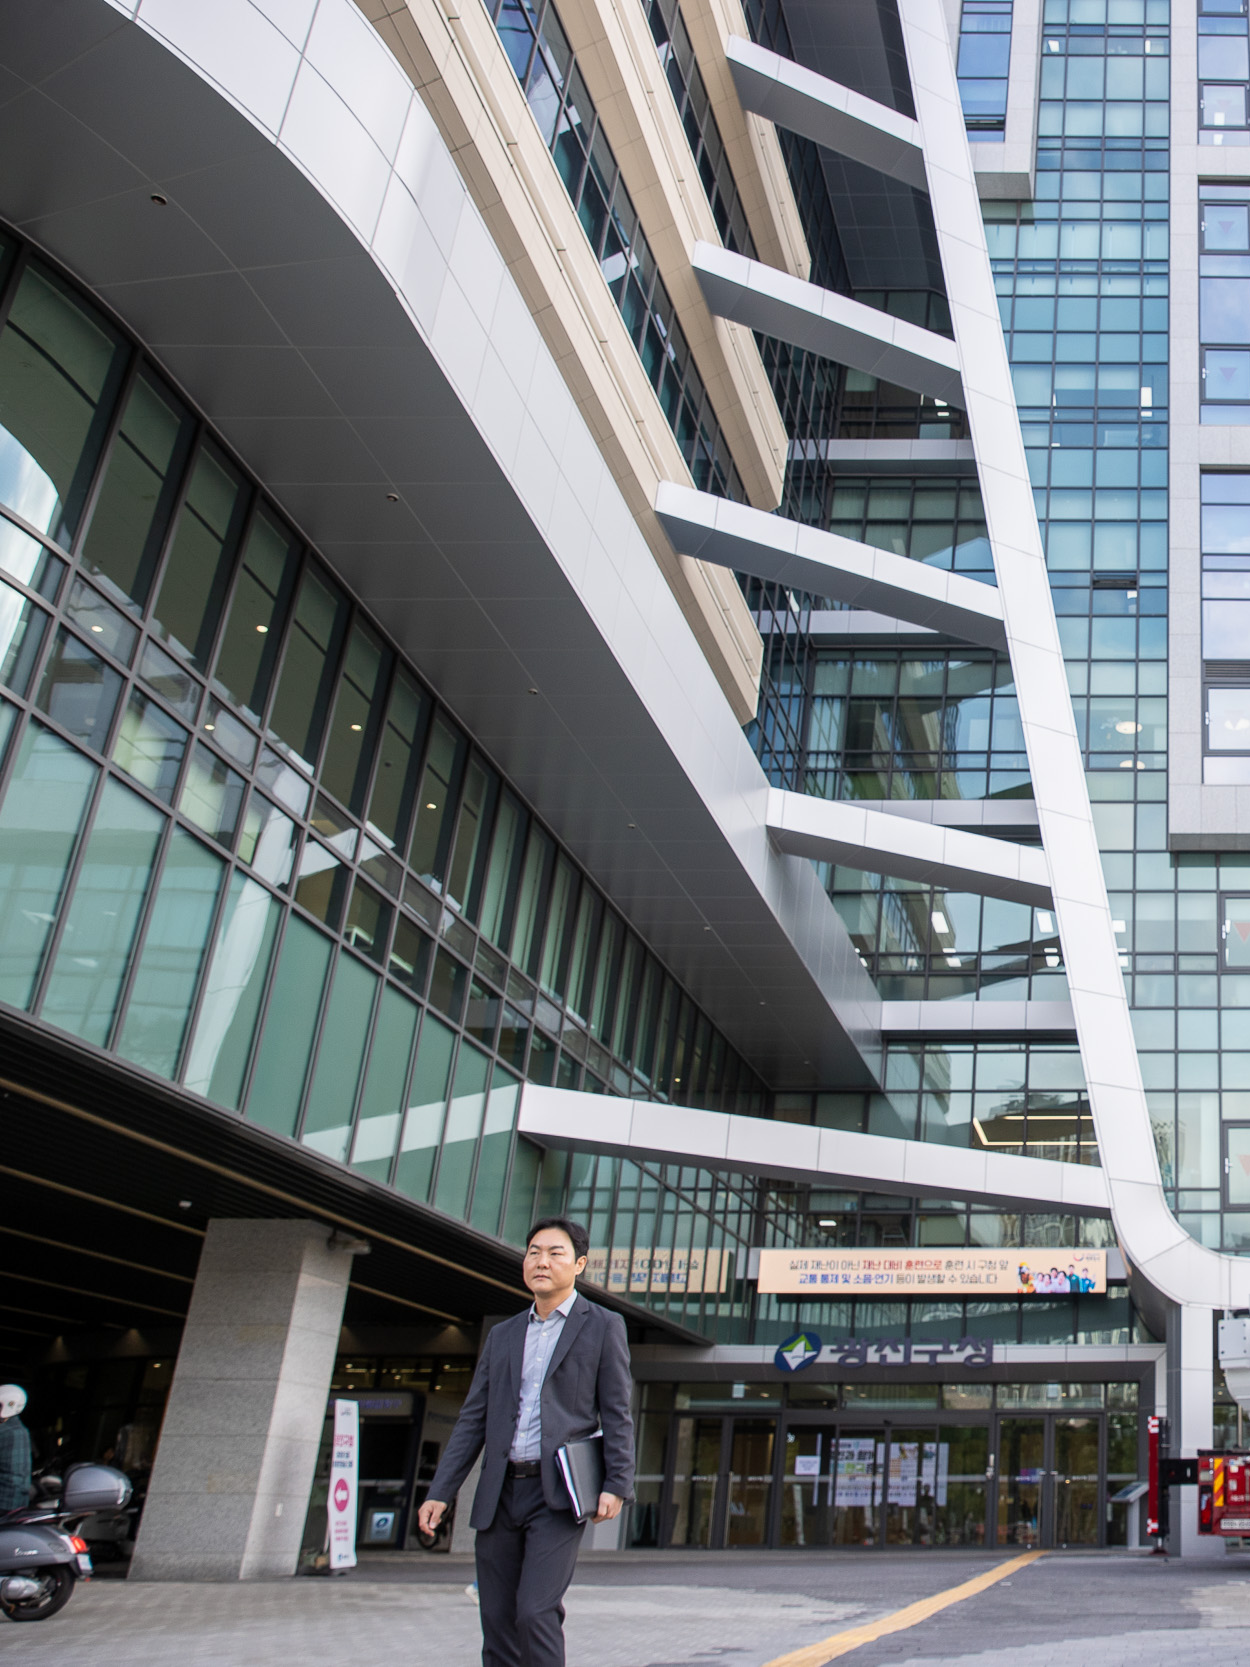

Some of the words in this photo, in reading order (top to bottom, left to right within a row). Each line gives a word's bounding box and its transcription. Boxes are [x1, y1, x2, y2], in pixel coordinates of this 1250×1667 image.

[789, 1260, 808, 1271] 실제
[810, 1260, 839, 1271] 재난이
[840, 1260, 860, 1271] 아닌
[863, 1260, 881, 1271] 재난
[883, 1260, 902, 1271] 대비
[905, 1260, 942, 1271] 훈련으로
[944, 1260, 964, 1271] 훈련
[967, 1260, 976, 1271] 시
[977, 1260, 997, 1271] 구청
[799, 1273, 817, 1285] 교통
[820, 1273, 839, 1285] 통제
[841, 1273, 851, 1285] 및
[896, 1273, 915, 1285] 등이
[917, 1273, 945, 1285] 발생할
[948, 1273, 957, 1285] 수
[959, 1273, 998, 1285] 있습니다
[830, 1335, 994, 1368] 광진구청
